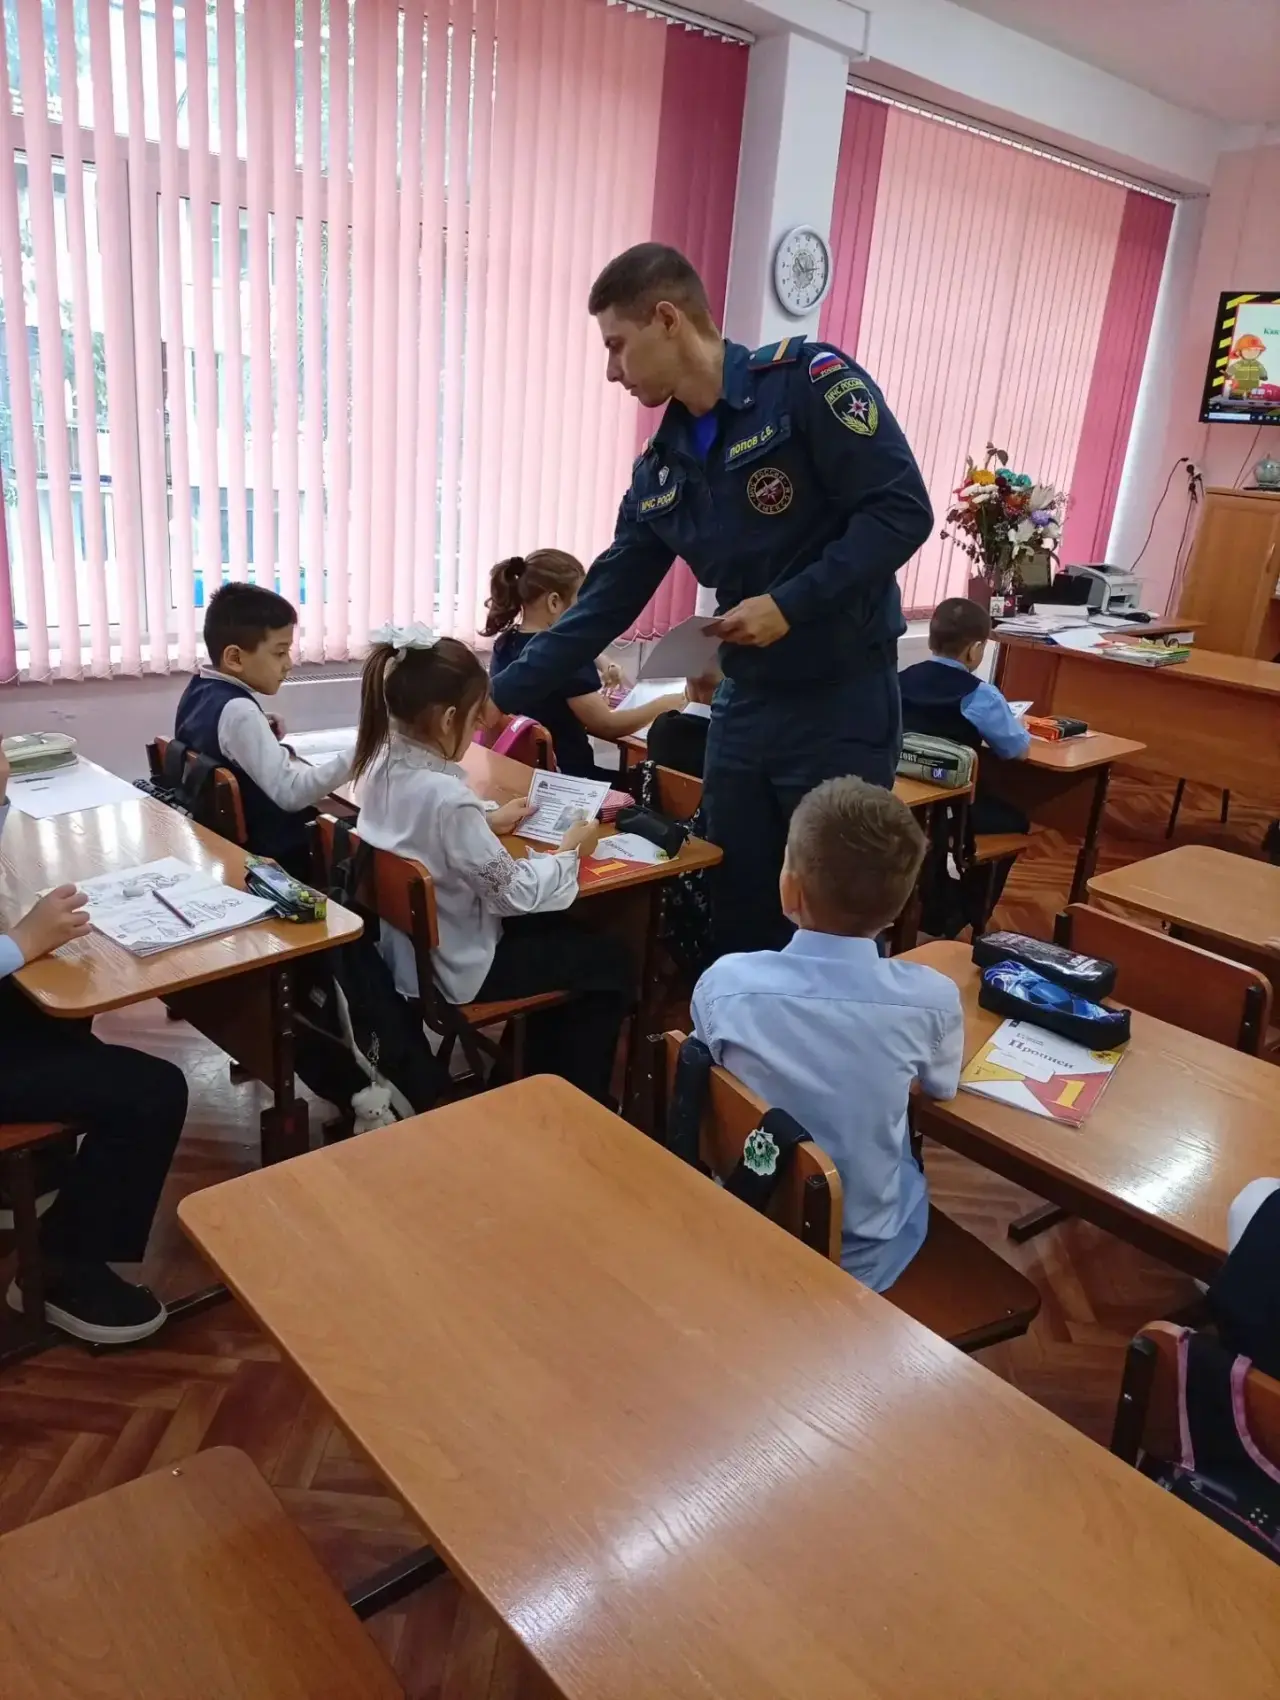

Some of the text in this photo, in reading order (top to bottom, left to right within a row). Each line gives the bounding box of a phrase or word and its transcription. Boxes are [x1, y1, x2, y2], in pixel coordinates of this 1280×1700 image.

[827, 387, 842, 402] МЧС
[730, 435, 758, 458] ПОПОВ
[1008, 1037, 1077, 1070] Прописи
[1045, 1077, 1087, 1111] 1
